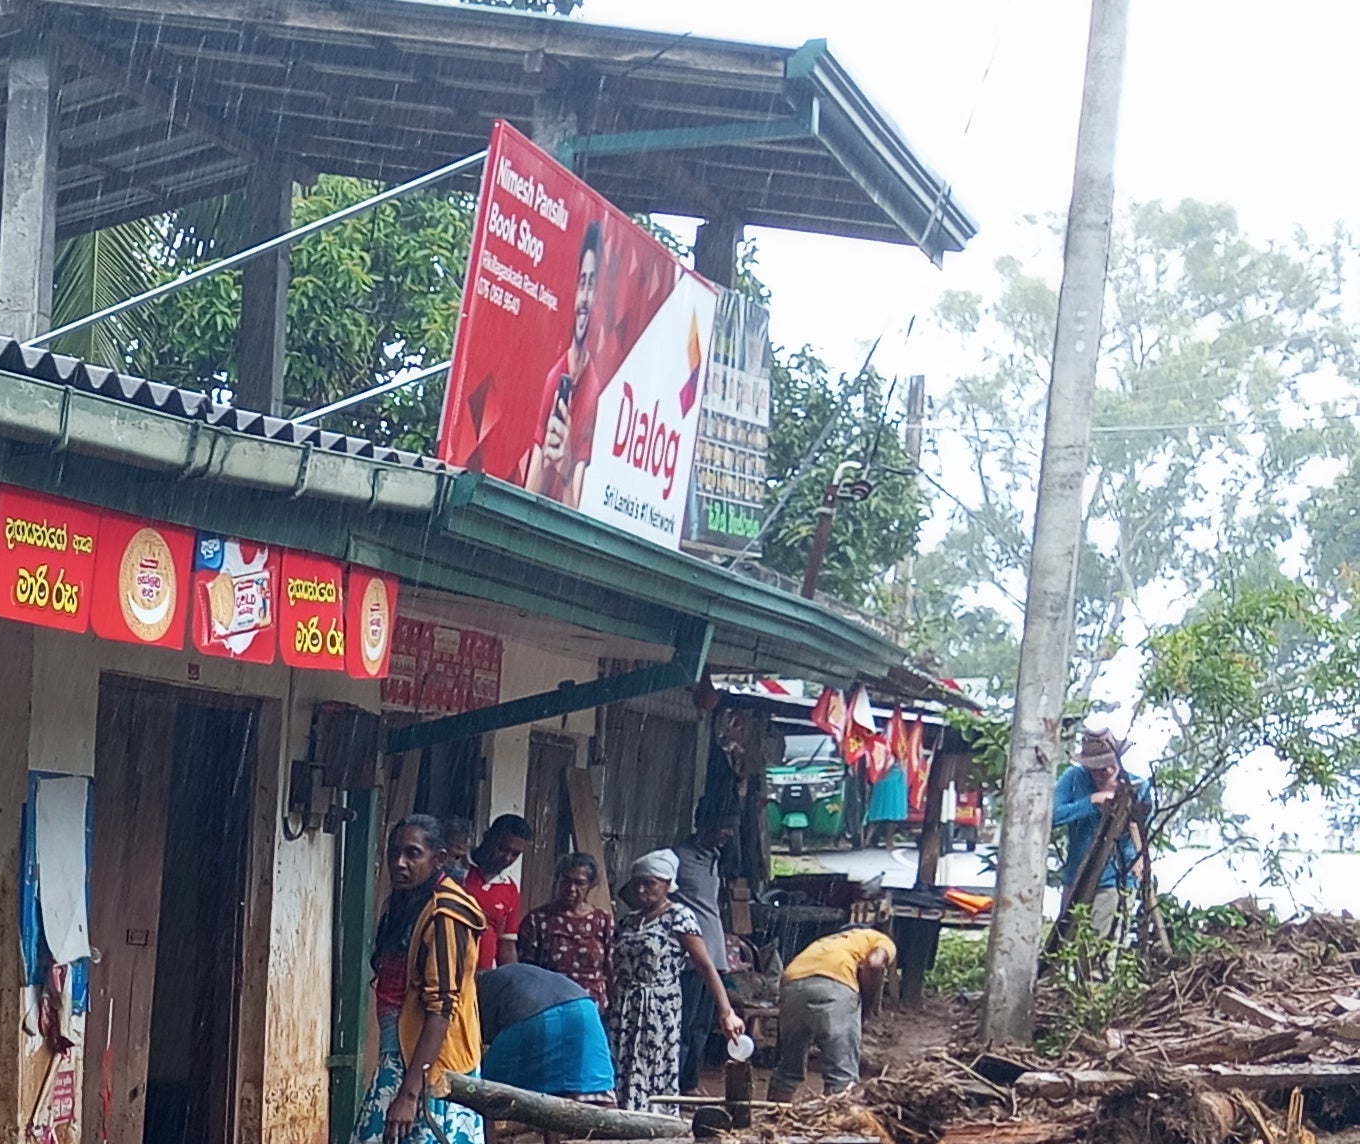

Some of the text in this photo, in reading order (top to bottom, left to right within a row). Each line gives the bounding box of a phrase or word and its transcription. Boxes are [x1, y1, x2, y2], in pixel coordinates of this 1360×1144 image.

[496, 155, 569, 232] Nimesh Pansilu
[488, 201, 544, 268] Book Shop
[612, 381, 681, 501] Dialog
[603, 484, 616, 507] Sri
[52, 568, 79, 614] රස
